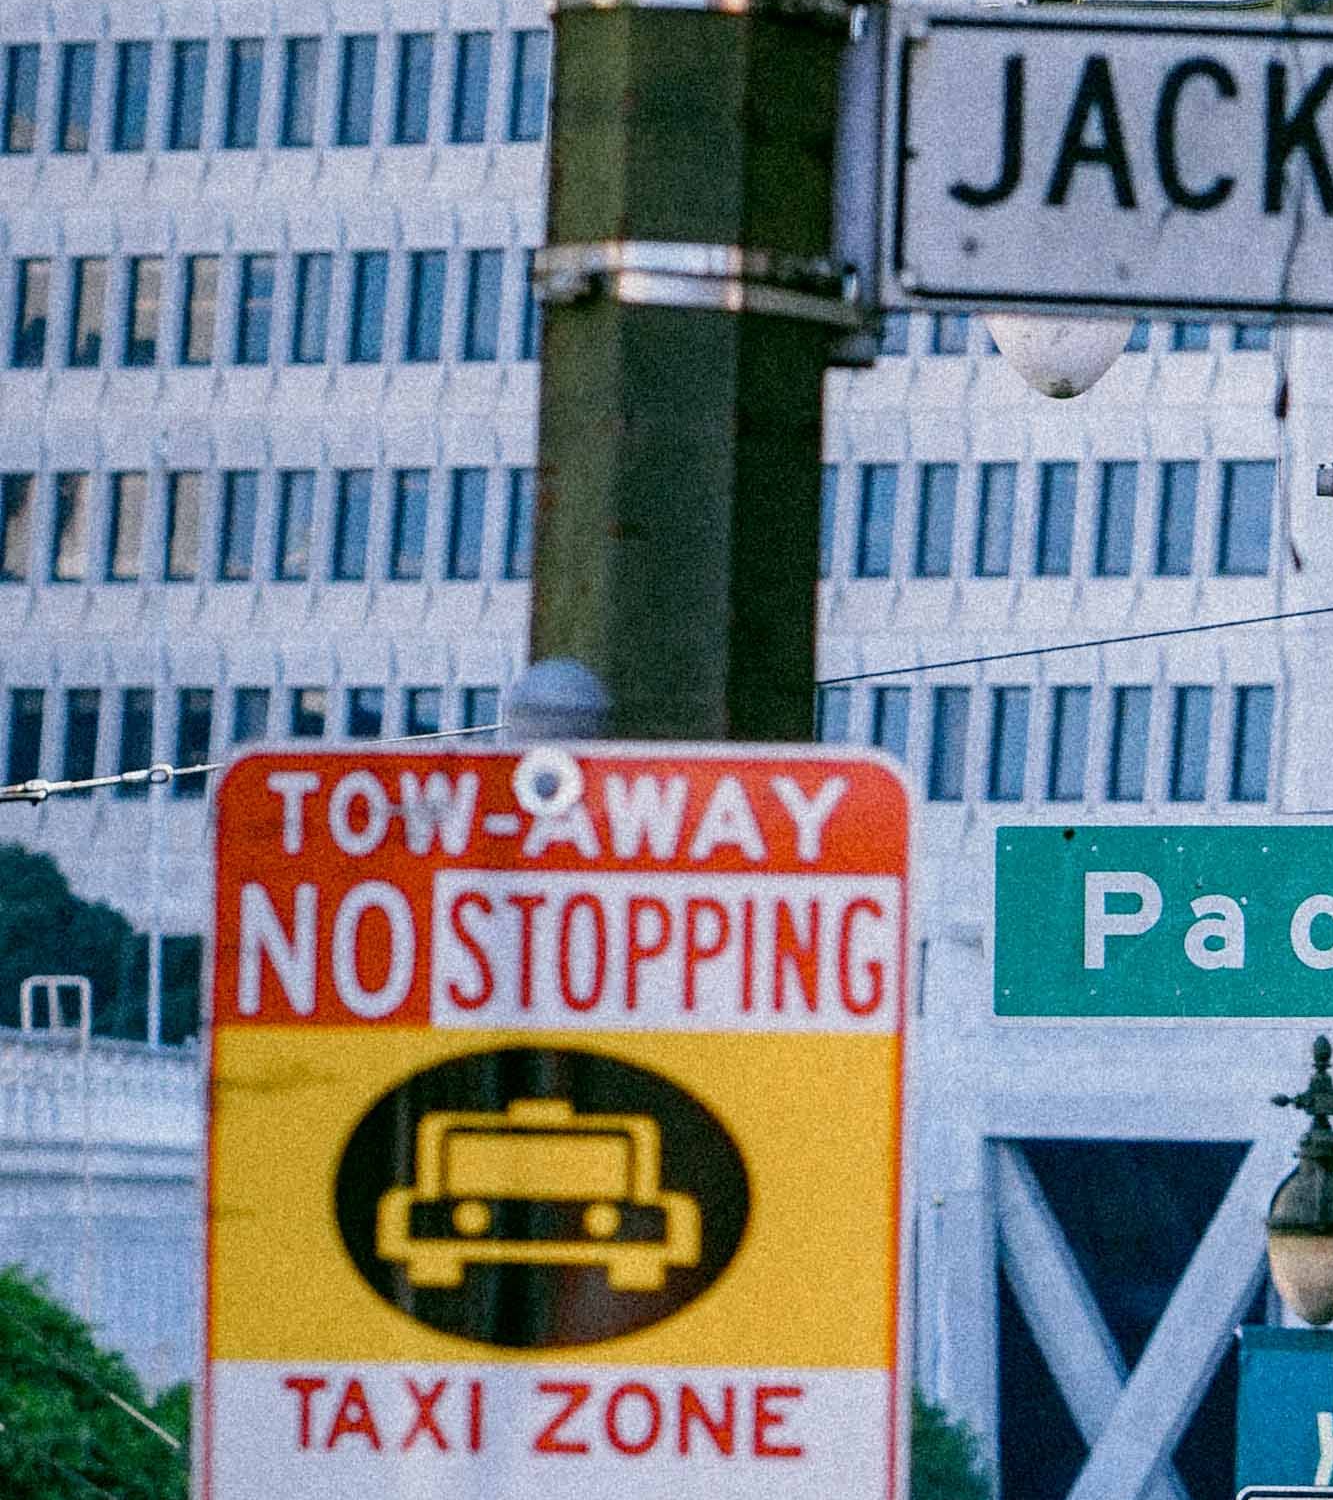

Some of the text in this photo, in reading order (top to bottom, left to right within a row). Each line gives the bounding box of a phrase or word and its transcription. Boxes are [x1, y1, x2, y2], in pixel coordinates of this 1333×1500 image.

[269, 770, 850, 860] TOW-AWAY
[238, 880, 884, 1021] NO STOPPING
[286, 1379, 803, 1458] TAXI ZONE
